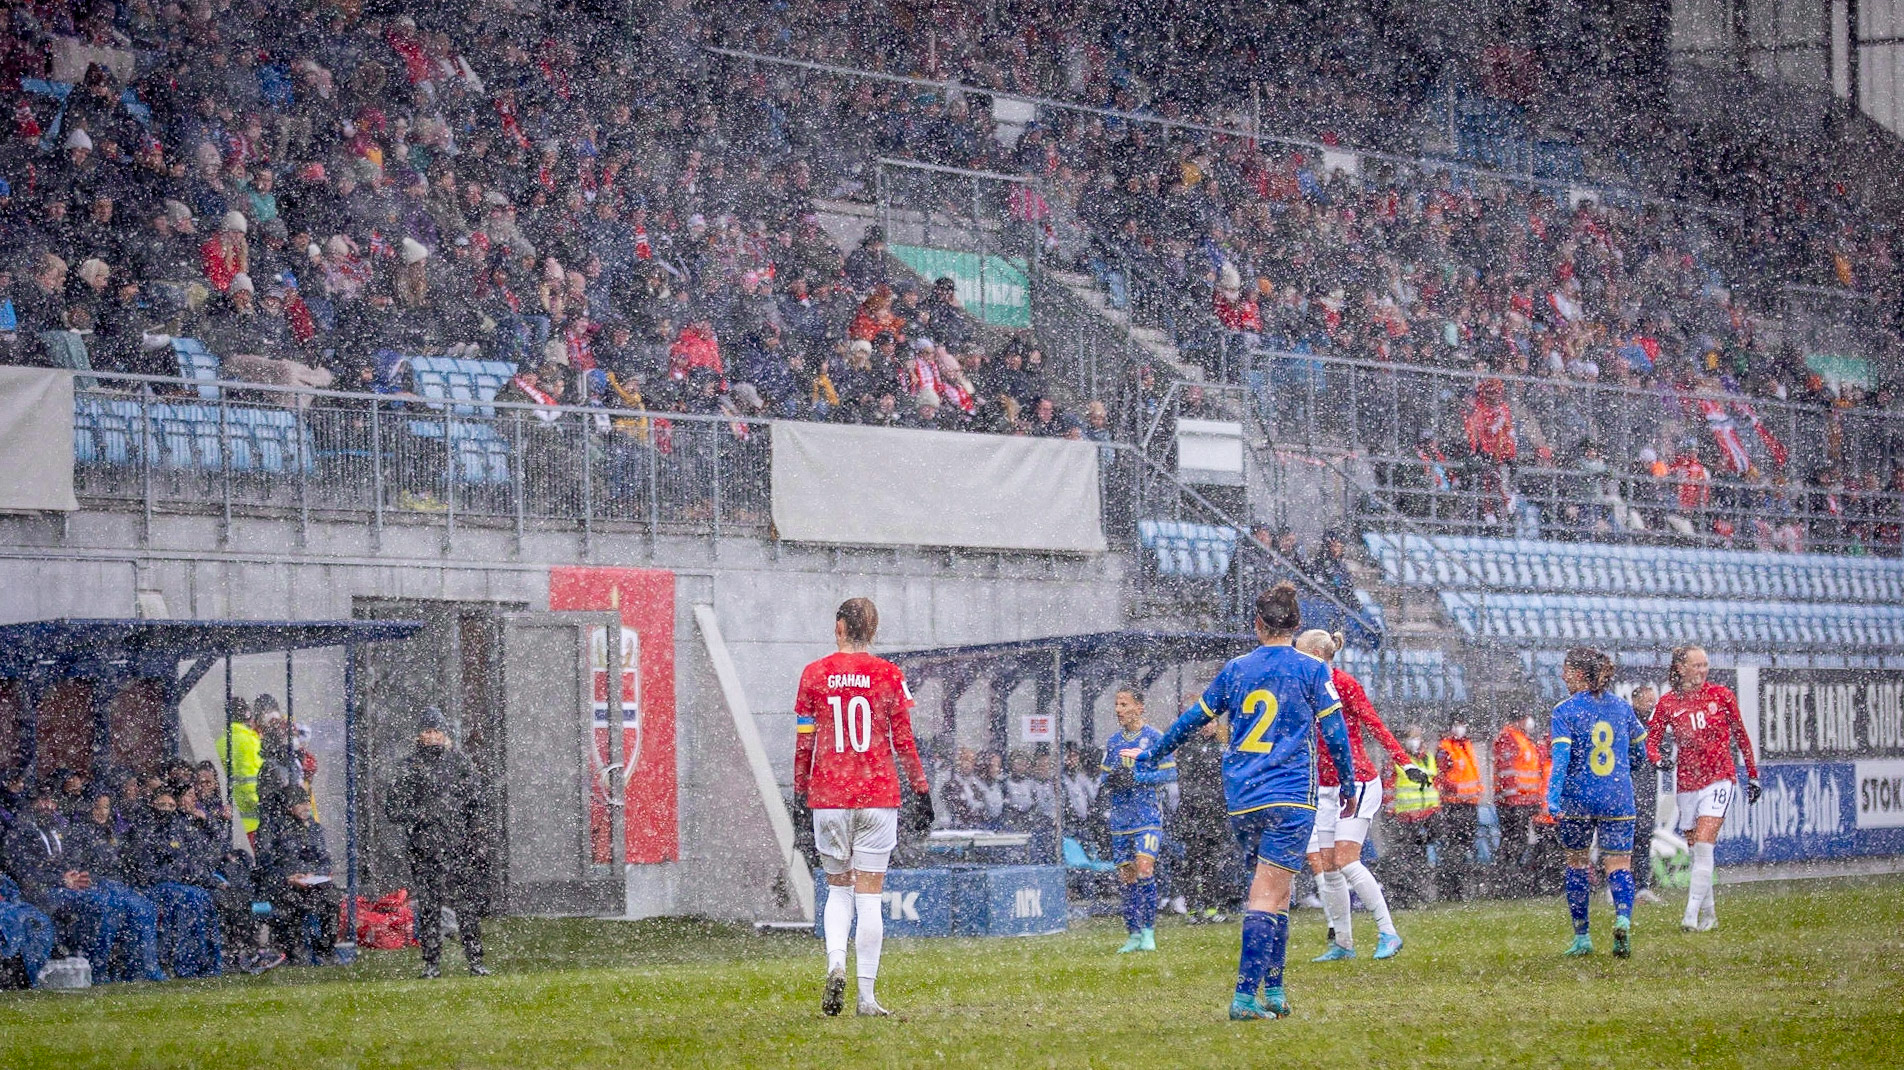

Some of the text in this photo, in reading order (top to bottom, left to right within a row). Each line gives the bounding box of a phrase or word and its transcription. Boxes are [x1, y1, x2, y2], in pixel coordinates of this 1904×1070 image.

[828, 673, 871, 689] GRAHAM
[827, 695, 872, 753] 10
[1238, 688, 1279, 754] 2
[1688, 711, 1707, 731] 18
[1765, 683, 1810, 751] EKTE
[1815, 683, 1858, 751] VARE
[1590, 720, 1616, 777] 8
[1712, 788, 1727, 804] 18
[1861, 776, 1902, 813] STOK
[1143, 832, 1160, 852] 10
